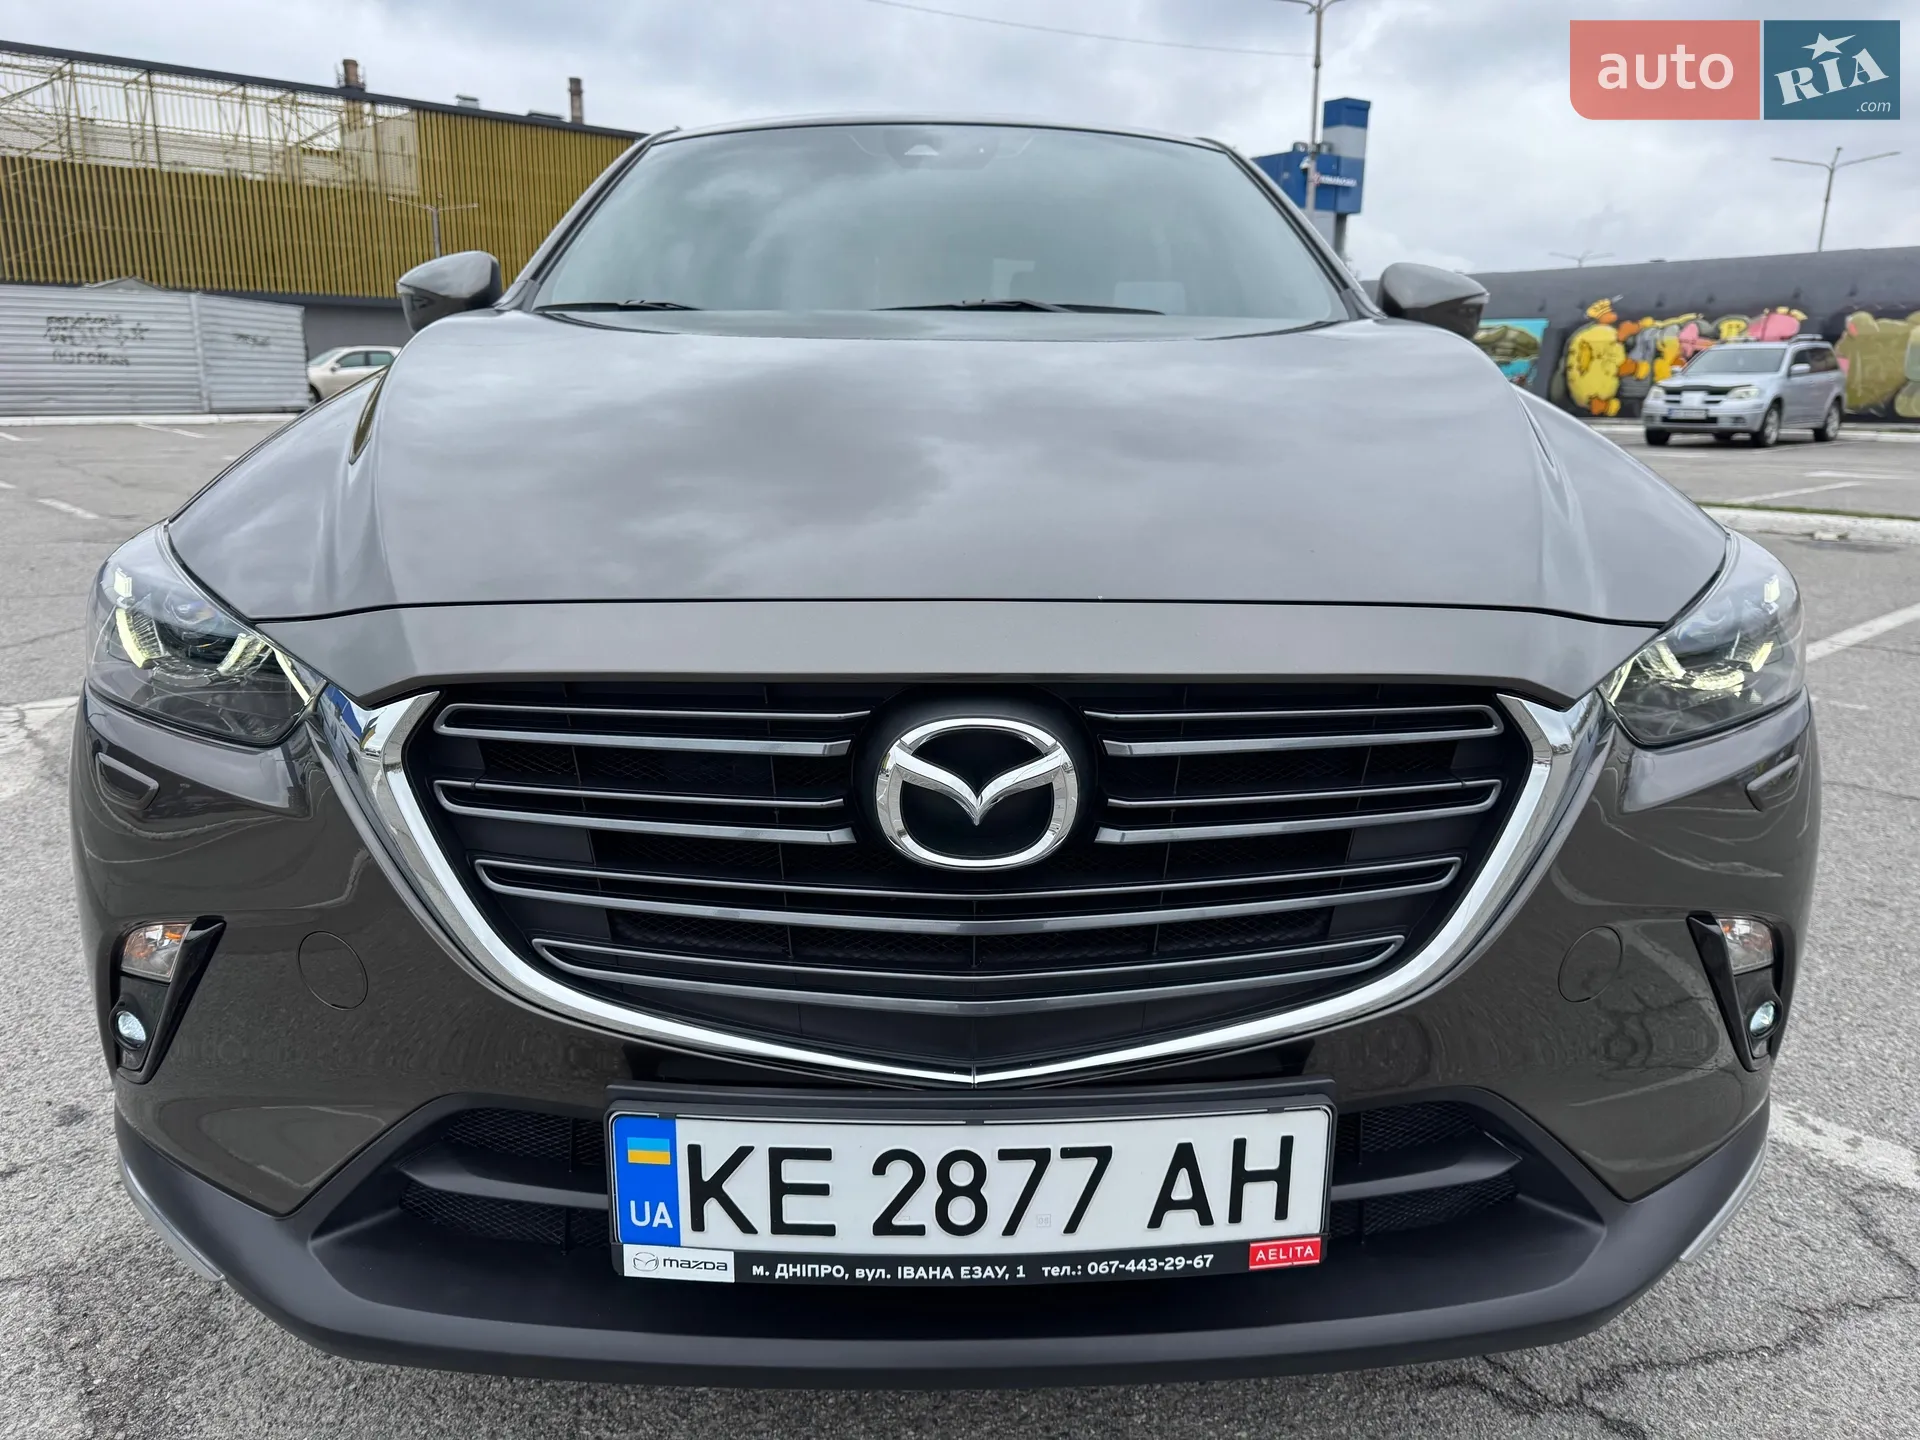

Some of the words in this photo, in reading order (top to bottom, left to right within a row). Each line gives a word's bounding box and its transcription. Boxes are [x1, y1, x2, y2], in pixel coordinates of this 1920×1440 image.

[687, 1143, 837, 1237] KE
[871, 1145, 1113, 1237] 2877
[1146, 1135, 1294, 1229] AH
[630, 1200, 674, 1229] UA
[752, 1265, 770, 1276] м.
[774, 1263, 850, 1281] ДНІПРО,
[855, 1268, 891, 1282] вул.
[897, 1266, 955, 1280] ІВАНА
[960, 1265, 1010, 1281] ЕЗАУ,
[1016, 1264, 1026, 1278] 1
[1041, 1264, 1082, 1277] тел.:
[1087, 1253, 1214, 1276] 067-443-29-67
[1255, 1245, 1315, 1261] AELITA
